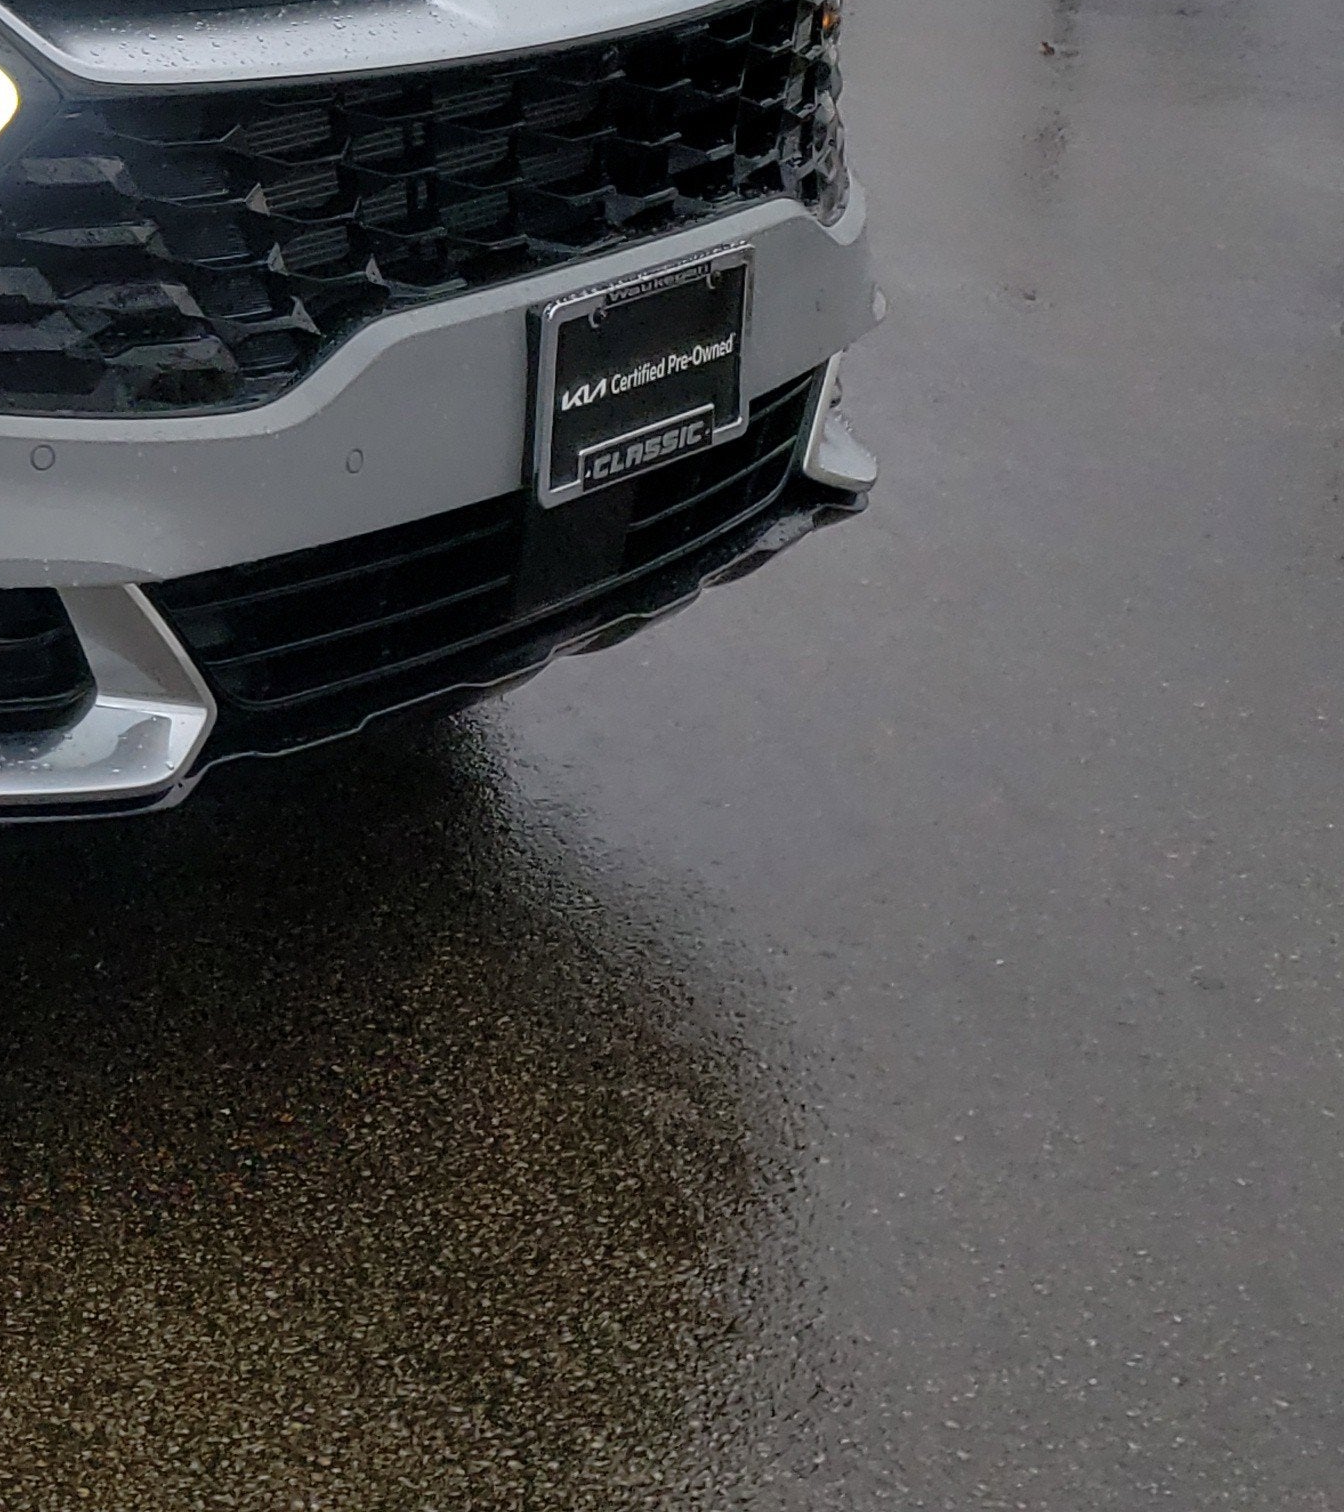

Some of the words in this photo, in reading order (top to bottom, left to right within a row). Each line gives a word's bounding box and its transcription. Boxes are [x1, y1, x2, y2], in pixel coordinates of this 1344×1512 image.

[562, 377, 607, 412] KIA
[611, 357, 665, 395] Certified
[667, 333, 735, 375] Pre-Owned
[592, 420, 705, 480] CLASSIC
